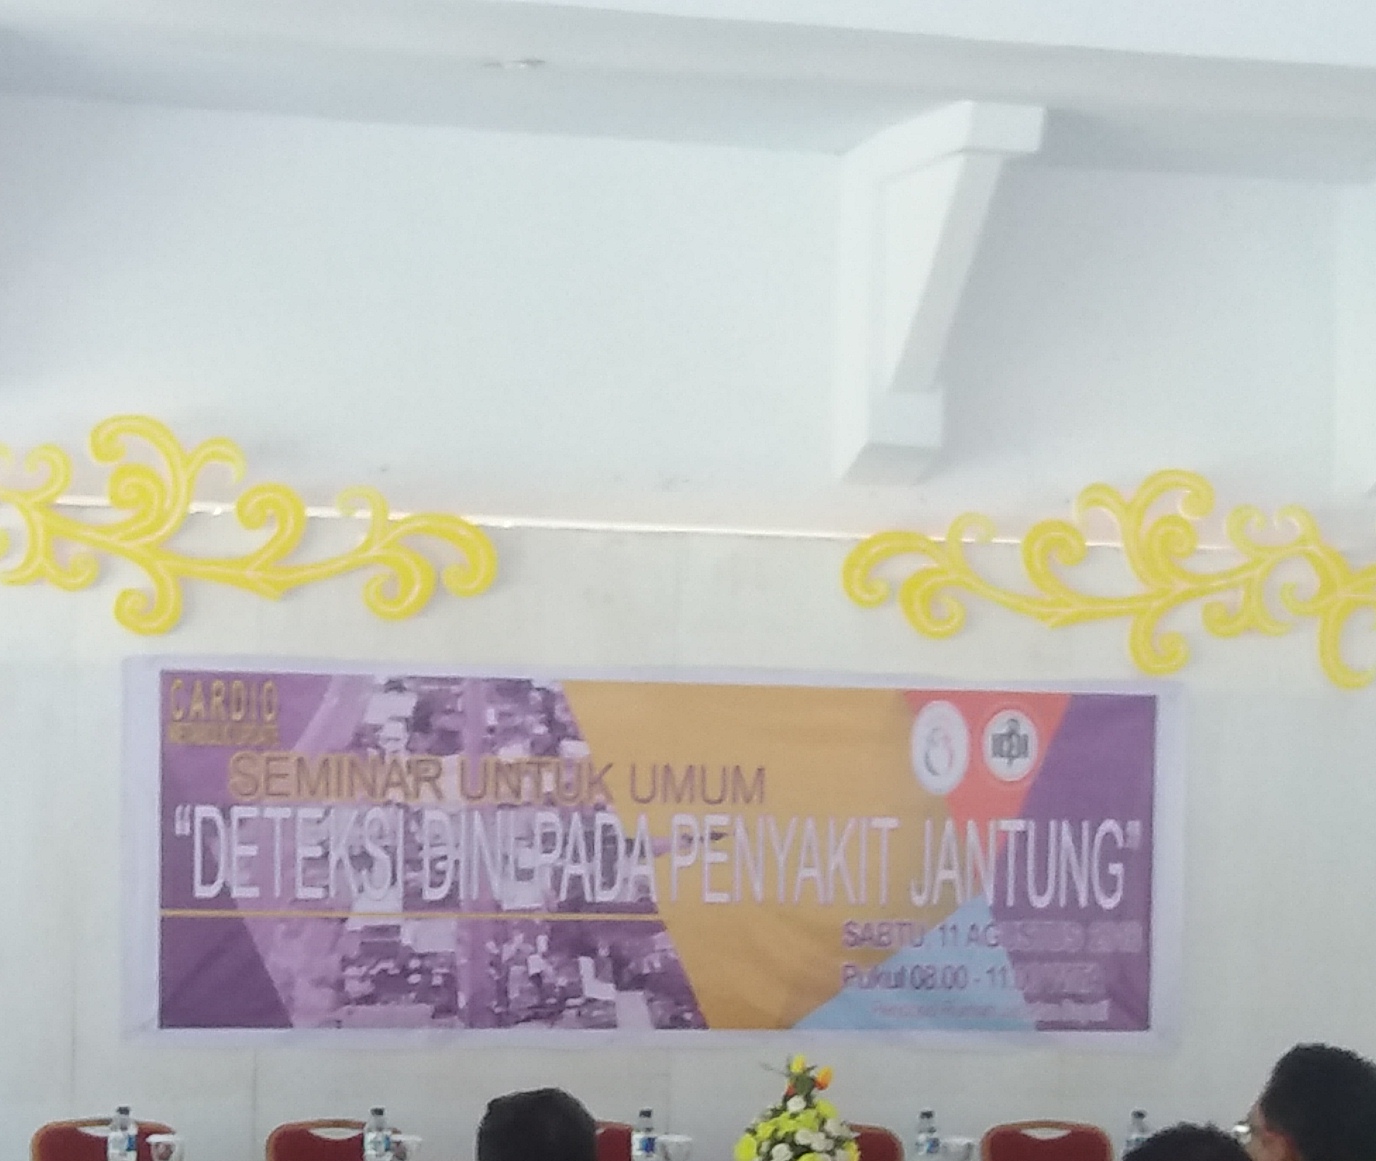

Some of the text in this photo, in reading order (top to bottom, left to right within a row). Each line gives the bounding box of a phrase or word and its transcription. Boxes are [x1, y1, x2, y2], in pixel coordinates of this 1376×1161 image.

[171, 679, 277, 721] CARDIO
[228, 751, 766, 805] SEMINAR UNTUK UMUM
[533, 811, 658, 904] PADA
[670, 813, 900, 906] PENYAKIT
[939, 923, 958, 948] 11
